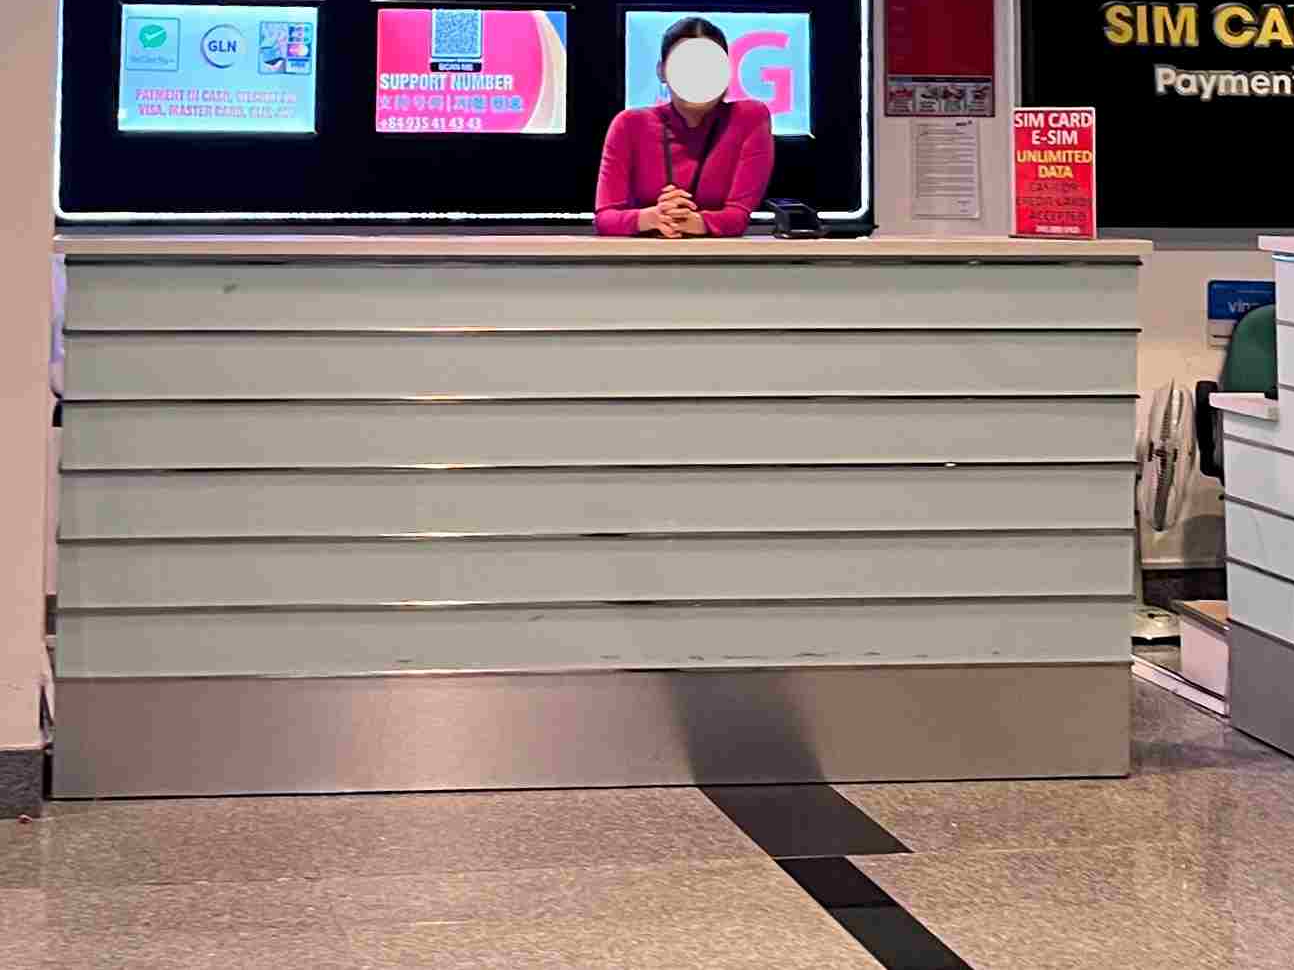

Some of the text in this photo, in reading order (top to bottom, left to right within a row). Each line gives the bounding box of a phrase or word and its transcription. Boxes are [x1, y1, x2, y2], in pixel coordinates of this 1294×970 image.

[1103, 3, 1198, 46] SIM
[207, 39, 237, 54] GLN
[380, 73, 514, 91] SUPPORT NUMBER
[1014, 112, 1093, 128] SIM CARD
[1031, 130, 1078, 145] E-SIM
[1016, 150, 1093, 163] UNLIMITED
[1038, 165, 1074, 179] DATA
